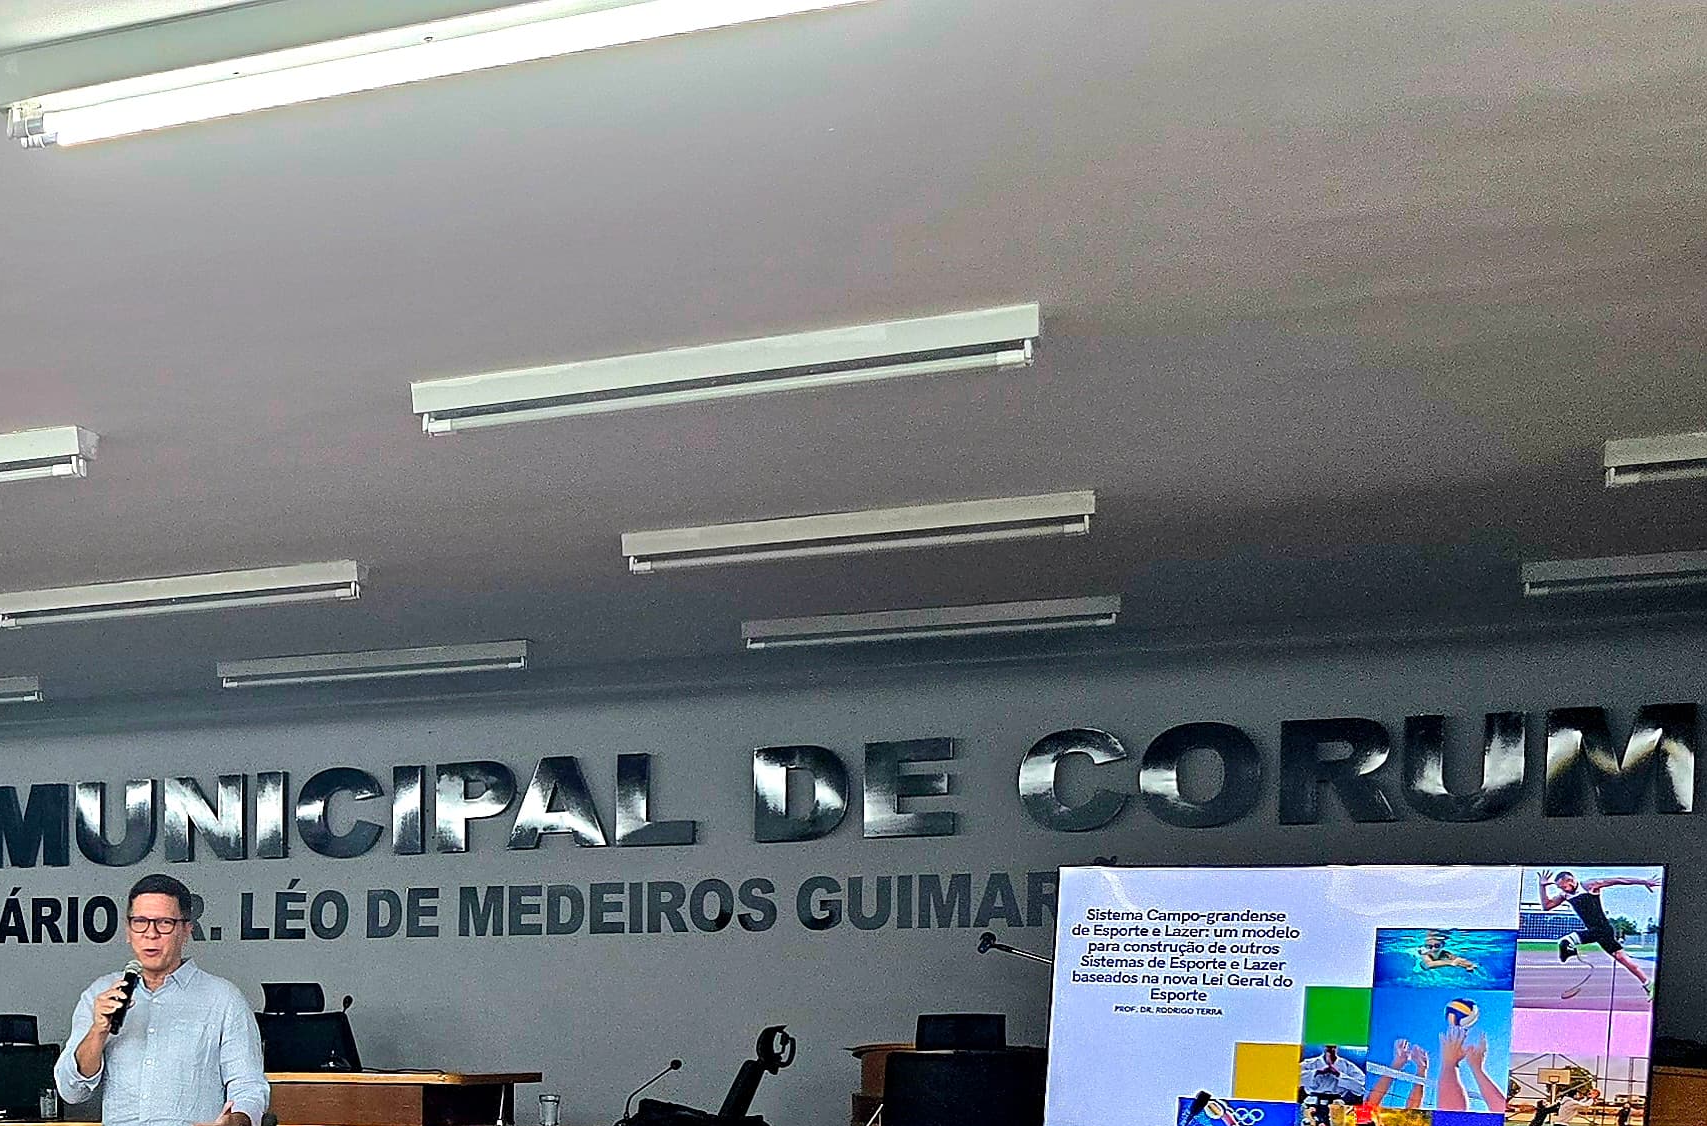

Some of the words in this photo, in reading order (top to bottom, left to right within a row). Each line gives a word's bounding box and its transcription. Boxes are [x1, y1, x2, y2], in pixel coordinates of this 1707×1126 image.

[752, 736, 956, 844] DE
[1018, 702, 1697, 831] CORUM
[240, 879, 349, 940] LÉO
[366, 886, 440, 939] DE
[459, 878, 777, 937] MEDEIROS
[796, 871, 1057, 932] GUIMAR
[1086, 908, 1143, 921] Sistema
[1146, 908, 1286, 925] Campo-grandense
[1071, 923, 1090, 936] de
[1093, 924, 1149, 940] Esporte
[1151, 927, 1161, 937] e
[1164, 924, 1210, 938] Lazer:
[1213, 928, 1239, 938] um
[1241, 925, 1300, 939] modelo
[1087, 942, 1120, 955] para
[1123, 940, 1205, 957] construção
[1207, 941, 1227, 954] de
[1229, 942, 1281, 955] outros
[1080, 954, 1145, 968] Sistemas
[1147, 956, 1166, 969] de
[1169, 956, 1227, 973] Esporte
[1230, 960, 1240, 970] e
[1243, 957, 1287, 971] Lazer
[1072, 970, 1139, 984] baseados
[1141, 975, 1159, 984] na
[1163, 975, 1198, 985] nova
[1202, 972, 1224, 986] Lei
[1227, 973, 1271, 988] Geral
[1272, 974, 1293, 988] do
[1150, 987, 1208, 1004] Esporte
[1155, 1006, 1195, 1015] RODRIGO
[1195, 1007, 1223, 1016] TERRA
